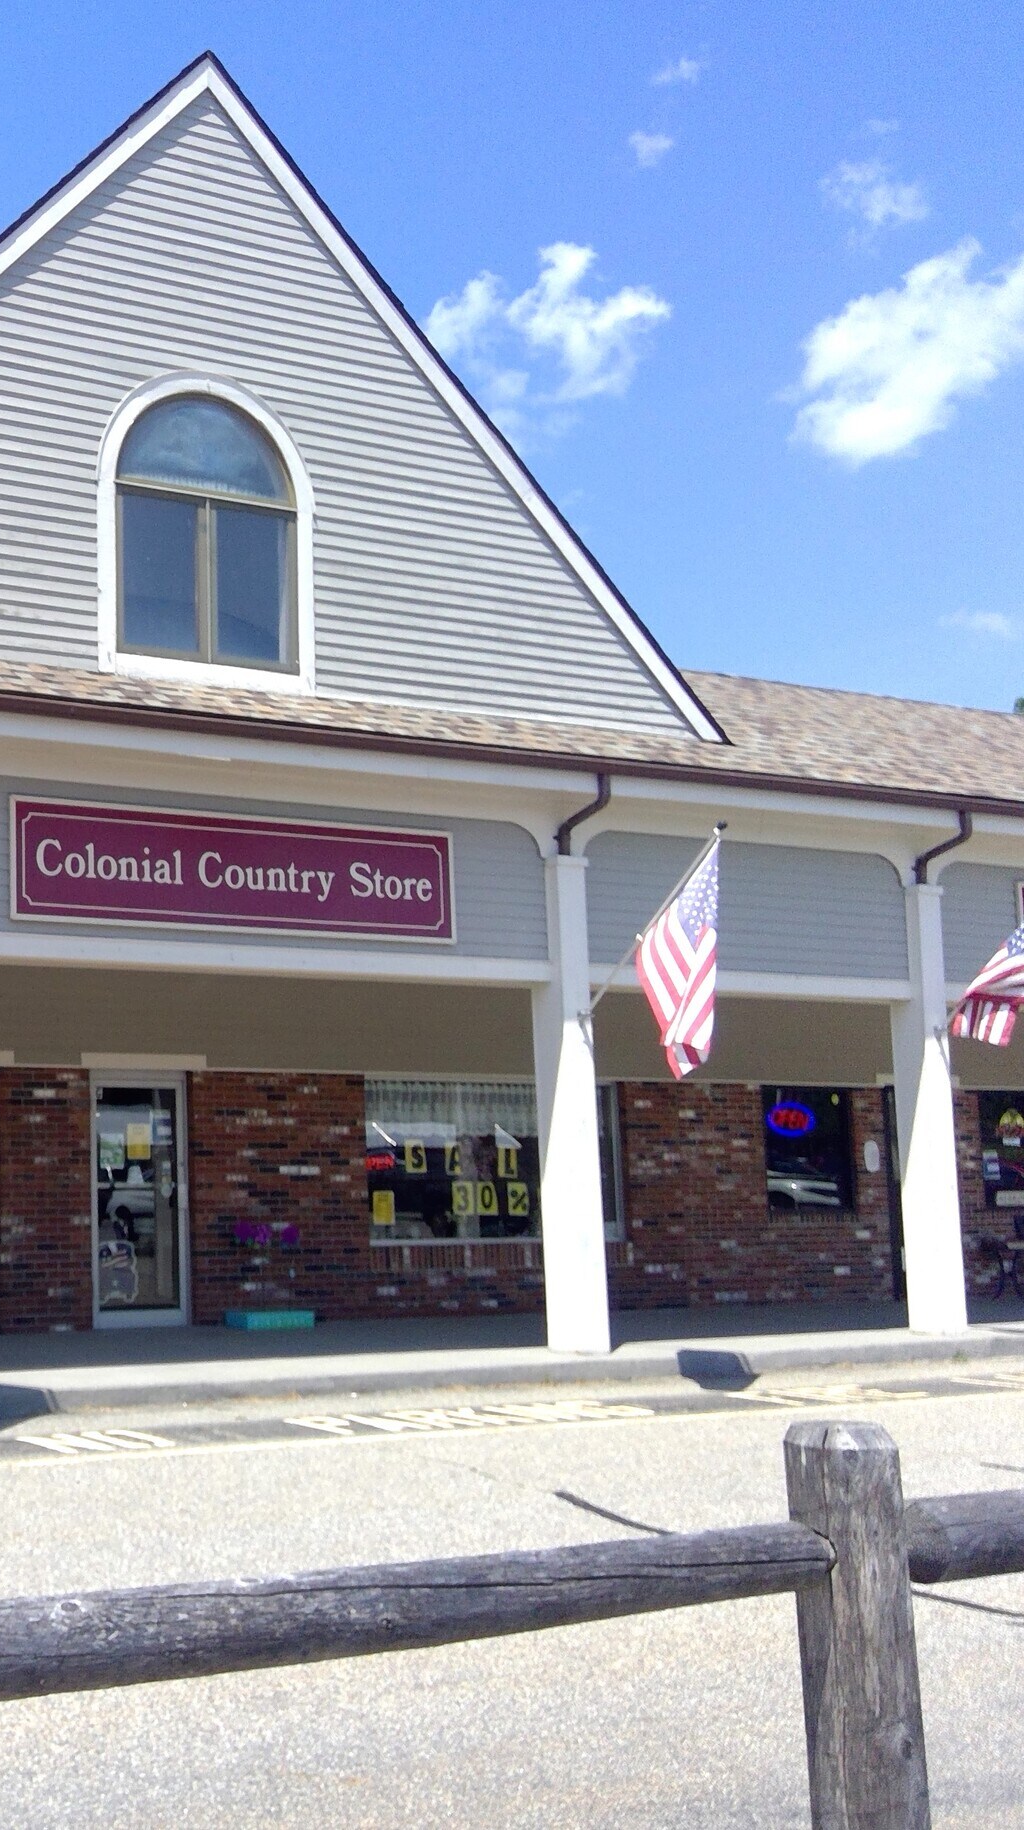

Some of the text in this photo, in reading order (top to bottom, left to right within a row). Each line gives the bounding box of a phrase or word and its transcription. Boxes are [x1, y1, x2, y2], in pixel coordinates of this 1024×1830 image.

[35, 838, 433, 902] Colonial Country Store
